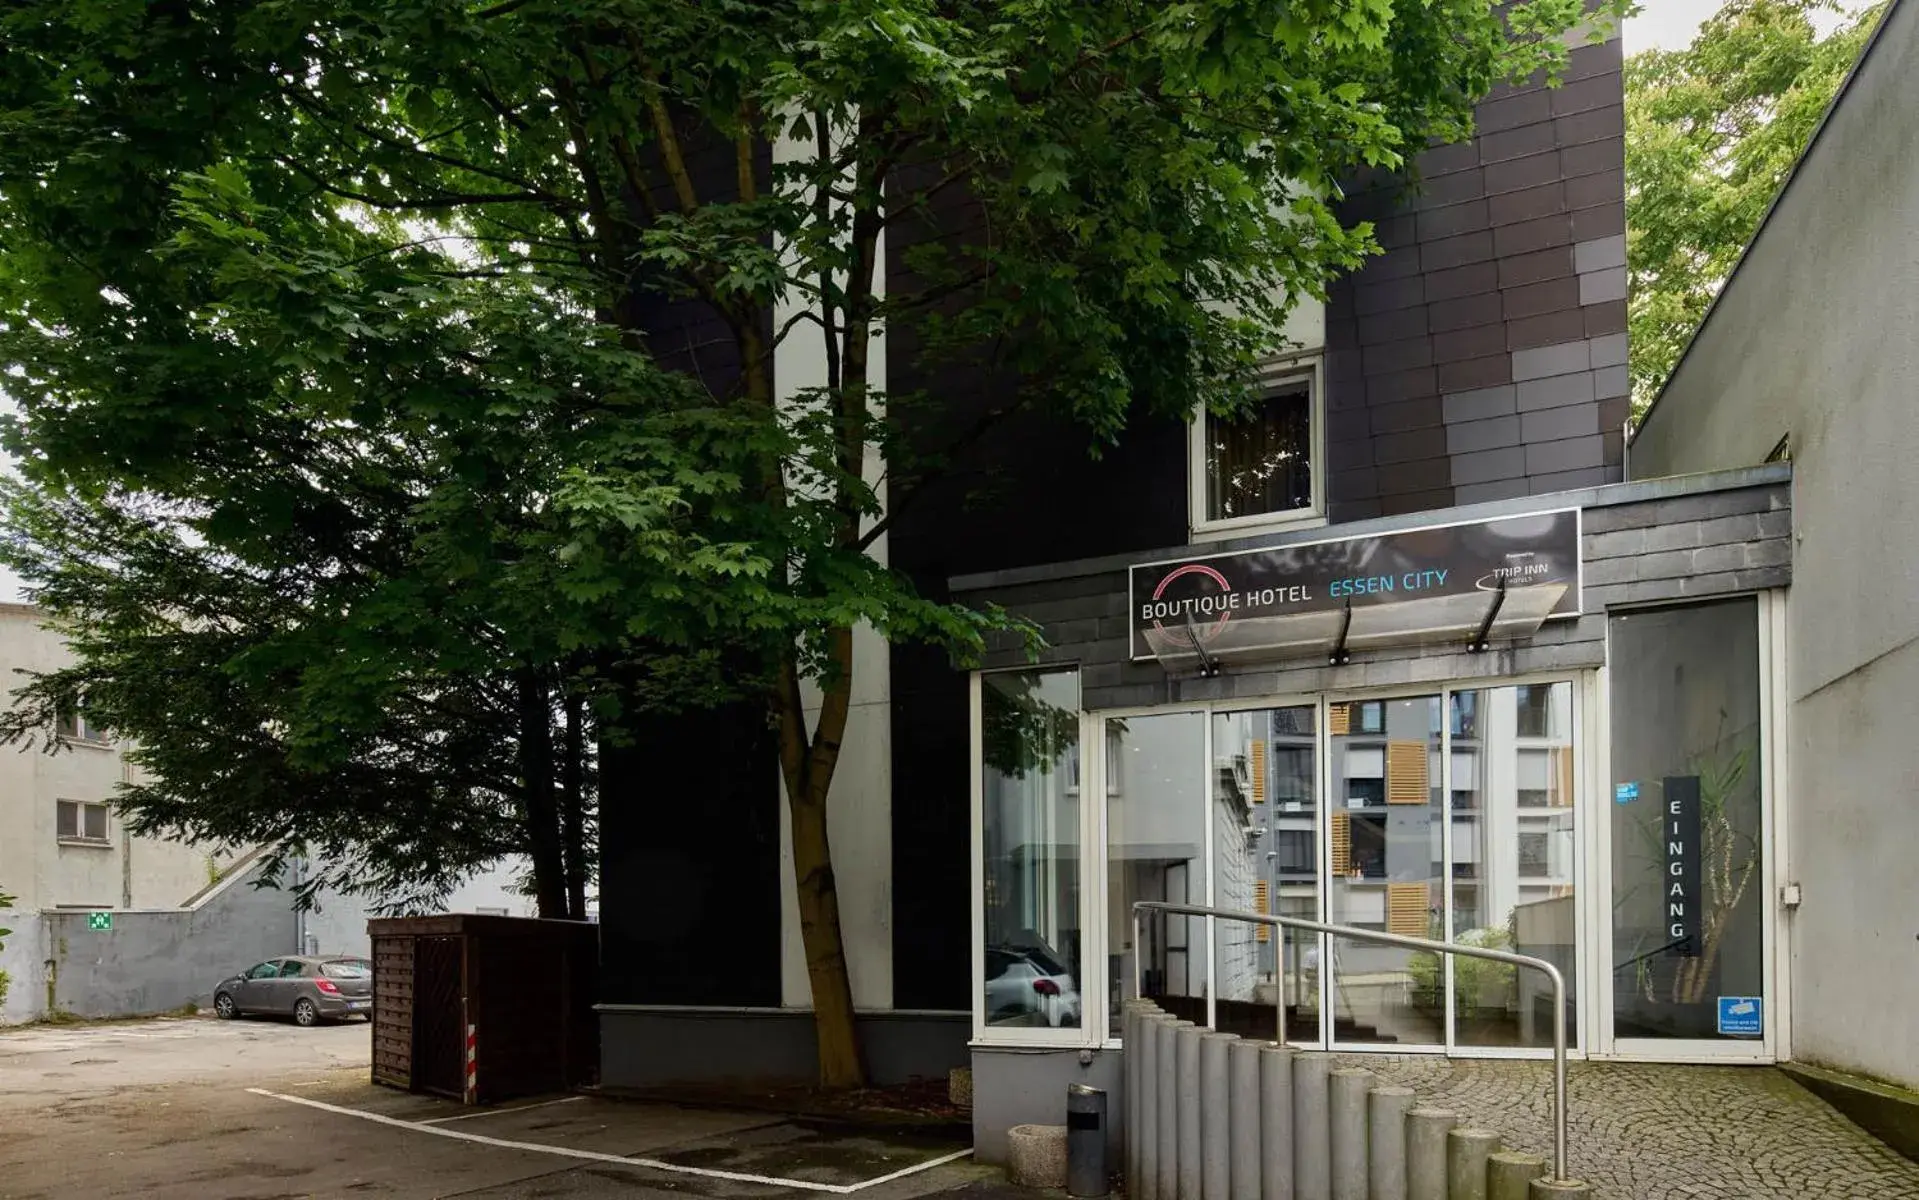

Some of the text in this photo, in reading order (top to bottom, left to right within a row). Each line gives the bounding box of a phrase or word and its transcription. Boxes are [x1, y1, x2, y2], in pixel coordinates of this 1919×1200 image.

[1142, 569, 1448, 620] BOUTIQUE HOTEL ESSEN CITY
[1493, 563, 1549, 579] TRIP INN
[1669, 800, 1684, 937] EINGANG
